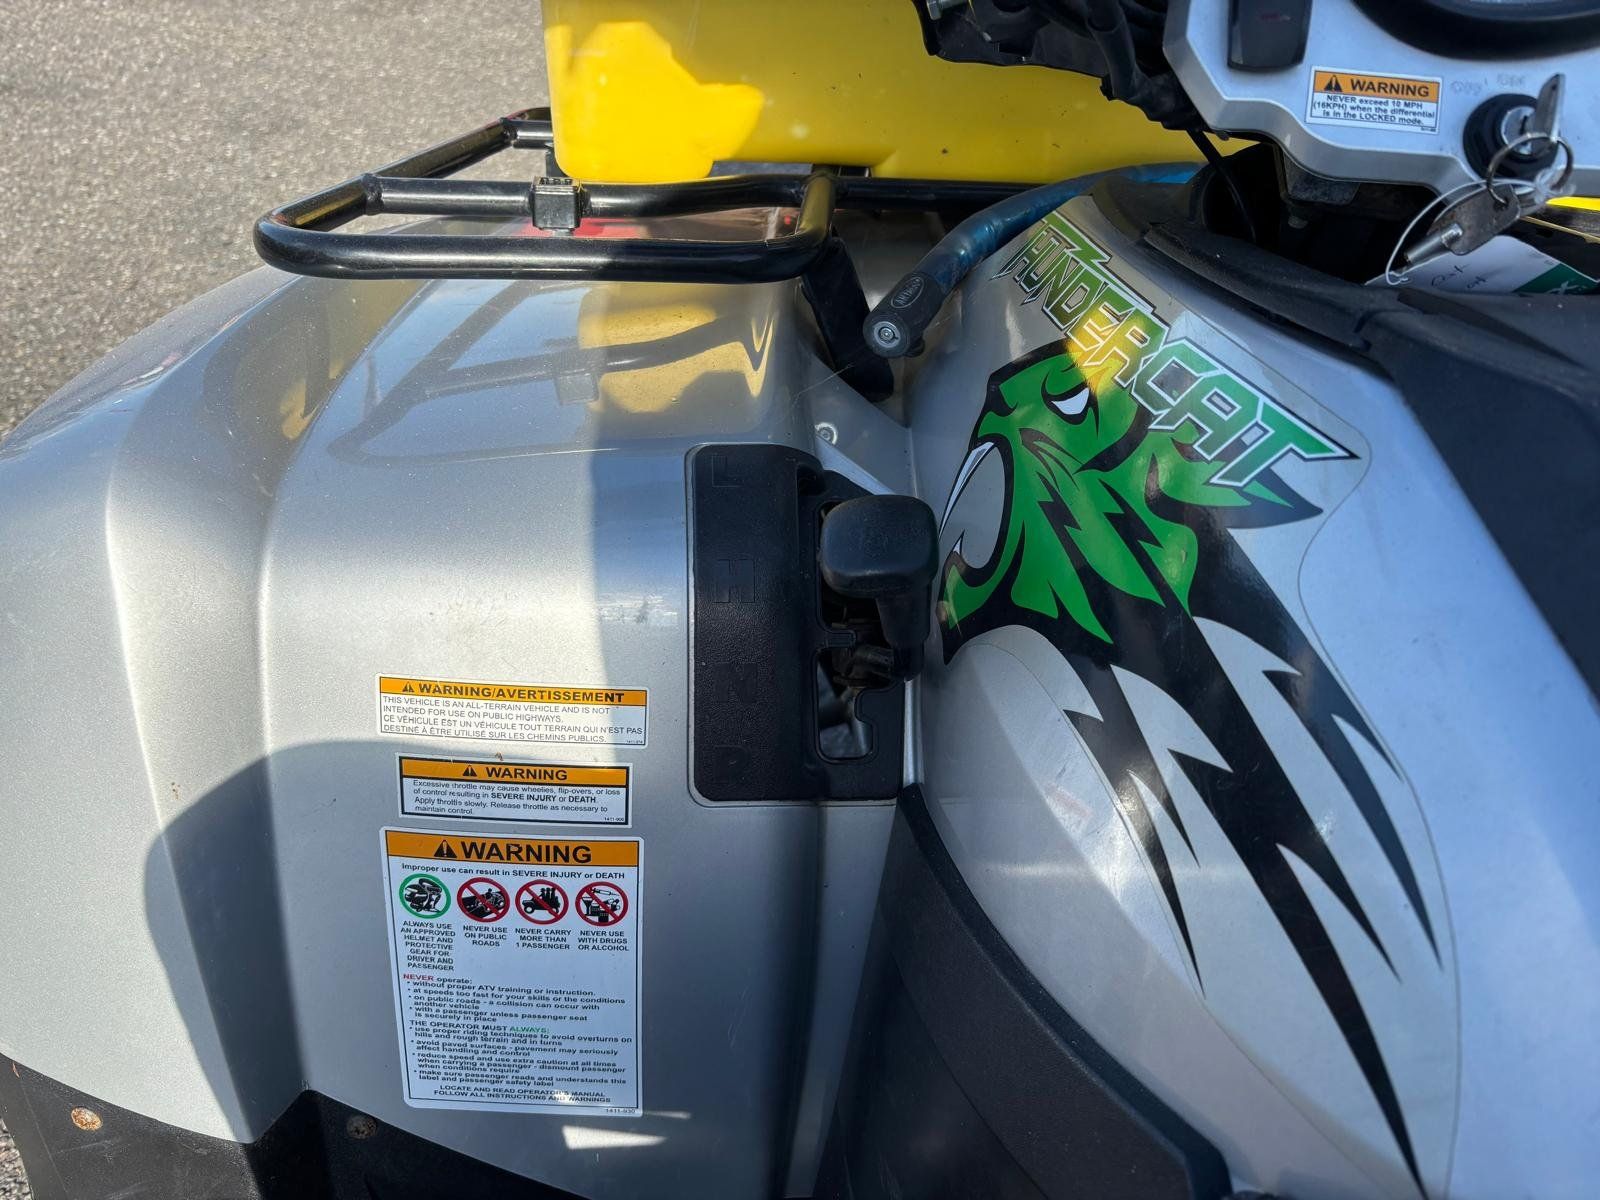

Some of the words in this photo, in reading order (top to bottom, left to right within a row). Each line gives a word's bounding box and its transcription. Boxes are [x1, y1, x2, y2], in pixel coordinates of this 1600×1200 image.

[1350, 78, 1430, 97] WARNING
[1327, 94, 1357, 103] NEVER
[1360, 97, 1388, 106] exceed
[1313, 100, 1347, 111] (16KPH)
[1350, 104, 1372, 112] when
[1375, 106, 1388, 114] the
[1390, 108, 1434, 118] differential
[1360, 113, 1396, 121] LOCKED
[1398, 116, 1424, 126] mode.
[990, 210, 1360, 487] THUNDERCAT
[711, 558, 756, 604] H
[418, 683, 624, 702] WARNING/AVERTISSEMENT
[403, 697, 439, 706] VEHICLE
[466, 701, 521, 711] ALL-TERRAIN
[524, 704, 559, 712] VEHICLE
[384, 706, 425, 715] INTENDED
[448, 710, 465, 718] USE
[516, 714, 563, 723] HIGHWAYS.
[398, 714, 438, 725] VÉHICULE
[474, 719, 516, 730] VÉHICULE
[545, 725, 580, 733] TERRAIN
[384, 725, 419, 734] DESTINÉ
[422, 726, 427, 734] À
[430, 726, 451, 736] ÊTRE
[454, 730, 486, 738] UTILISÉ
[569, 735, 606, 743] PUBLICS.
[486, 766, 567, 780] WARNING
[413, 780, 450, 788] Excessive
[452, 782, 477, 790] throttle
[521, 786, 555, 795] wheelies,
[559, 787, 594, 796] flip-overs,
[422, 788, 447, 796] control
[449, 790, 480, 799] resulting
[491, 792, 524, 800] SEVERE
[526, 793, 557, 802] INJURY
[415, 797, 435, 806] Apply
[437, 798, 462, 806] throttle
[464, 800, 488, 809] slowly.
[561, 805, 598, 813] necessary
[460, 841, 592, 863] WARNING
[402, 863, 439, 874] Improper
[476, 868, 500, 876] result
[513, 870, 547, 878] SEVERE
[413, 928, 455, 936] APPROVED
[405, 942, 454, 950] PROTECTIVE
[407, 955, 435, 963] DRIVER
[408, 963, 454, 971] PASSENGER
[437, 977, 472, 985] operate:
[498, 986, 532, 994] training
[430, 1021, 479, 1030] OPERATOR
[442, 1064, 487, 1072] conditions
